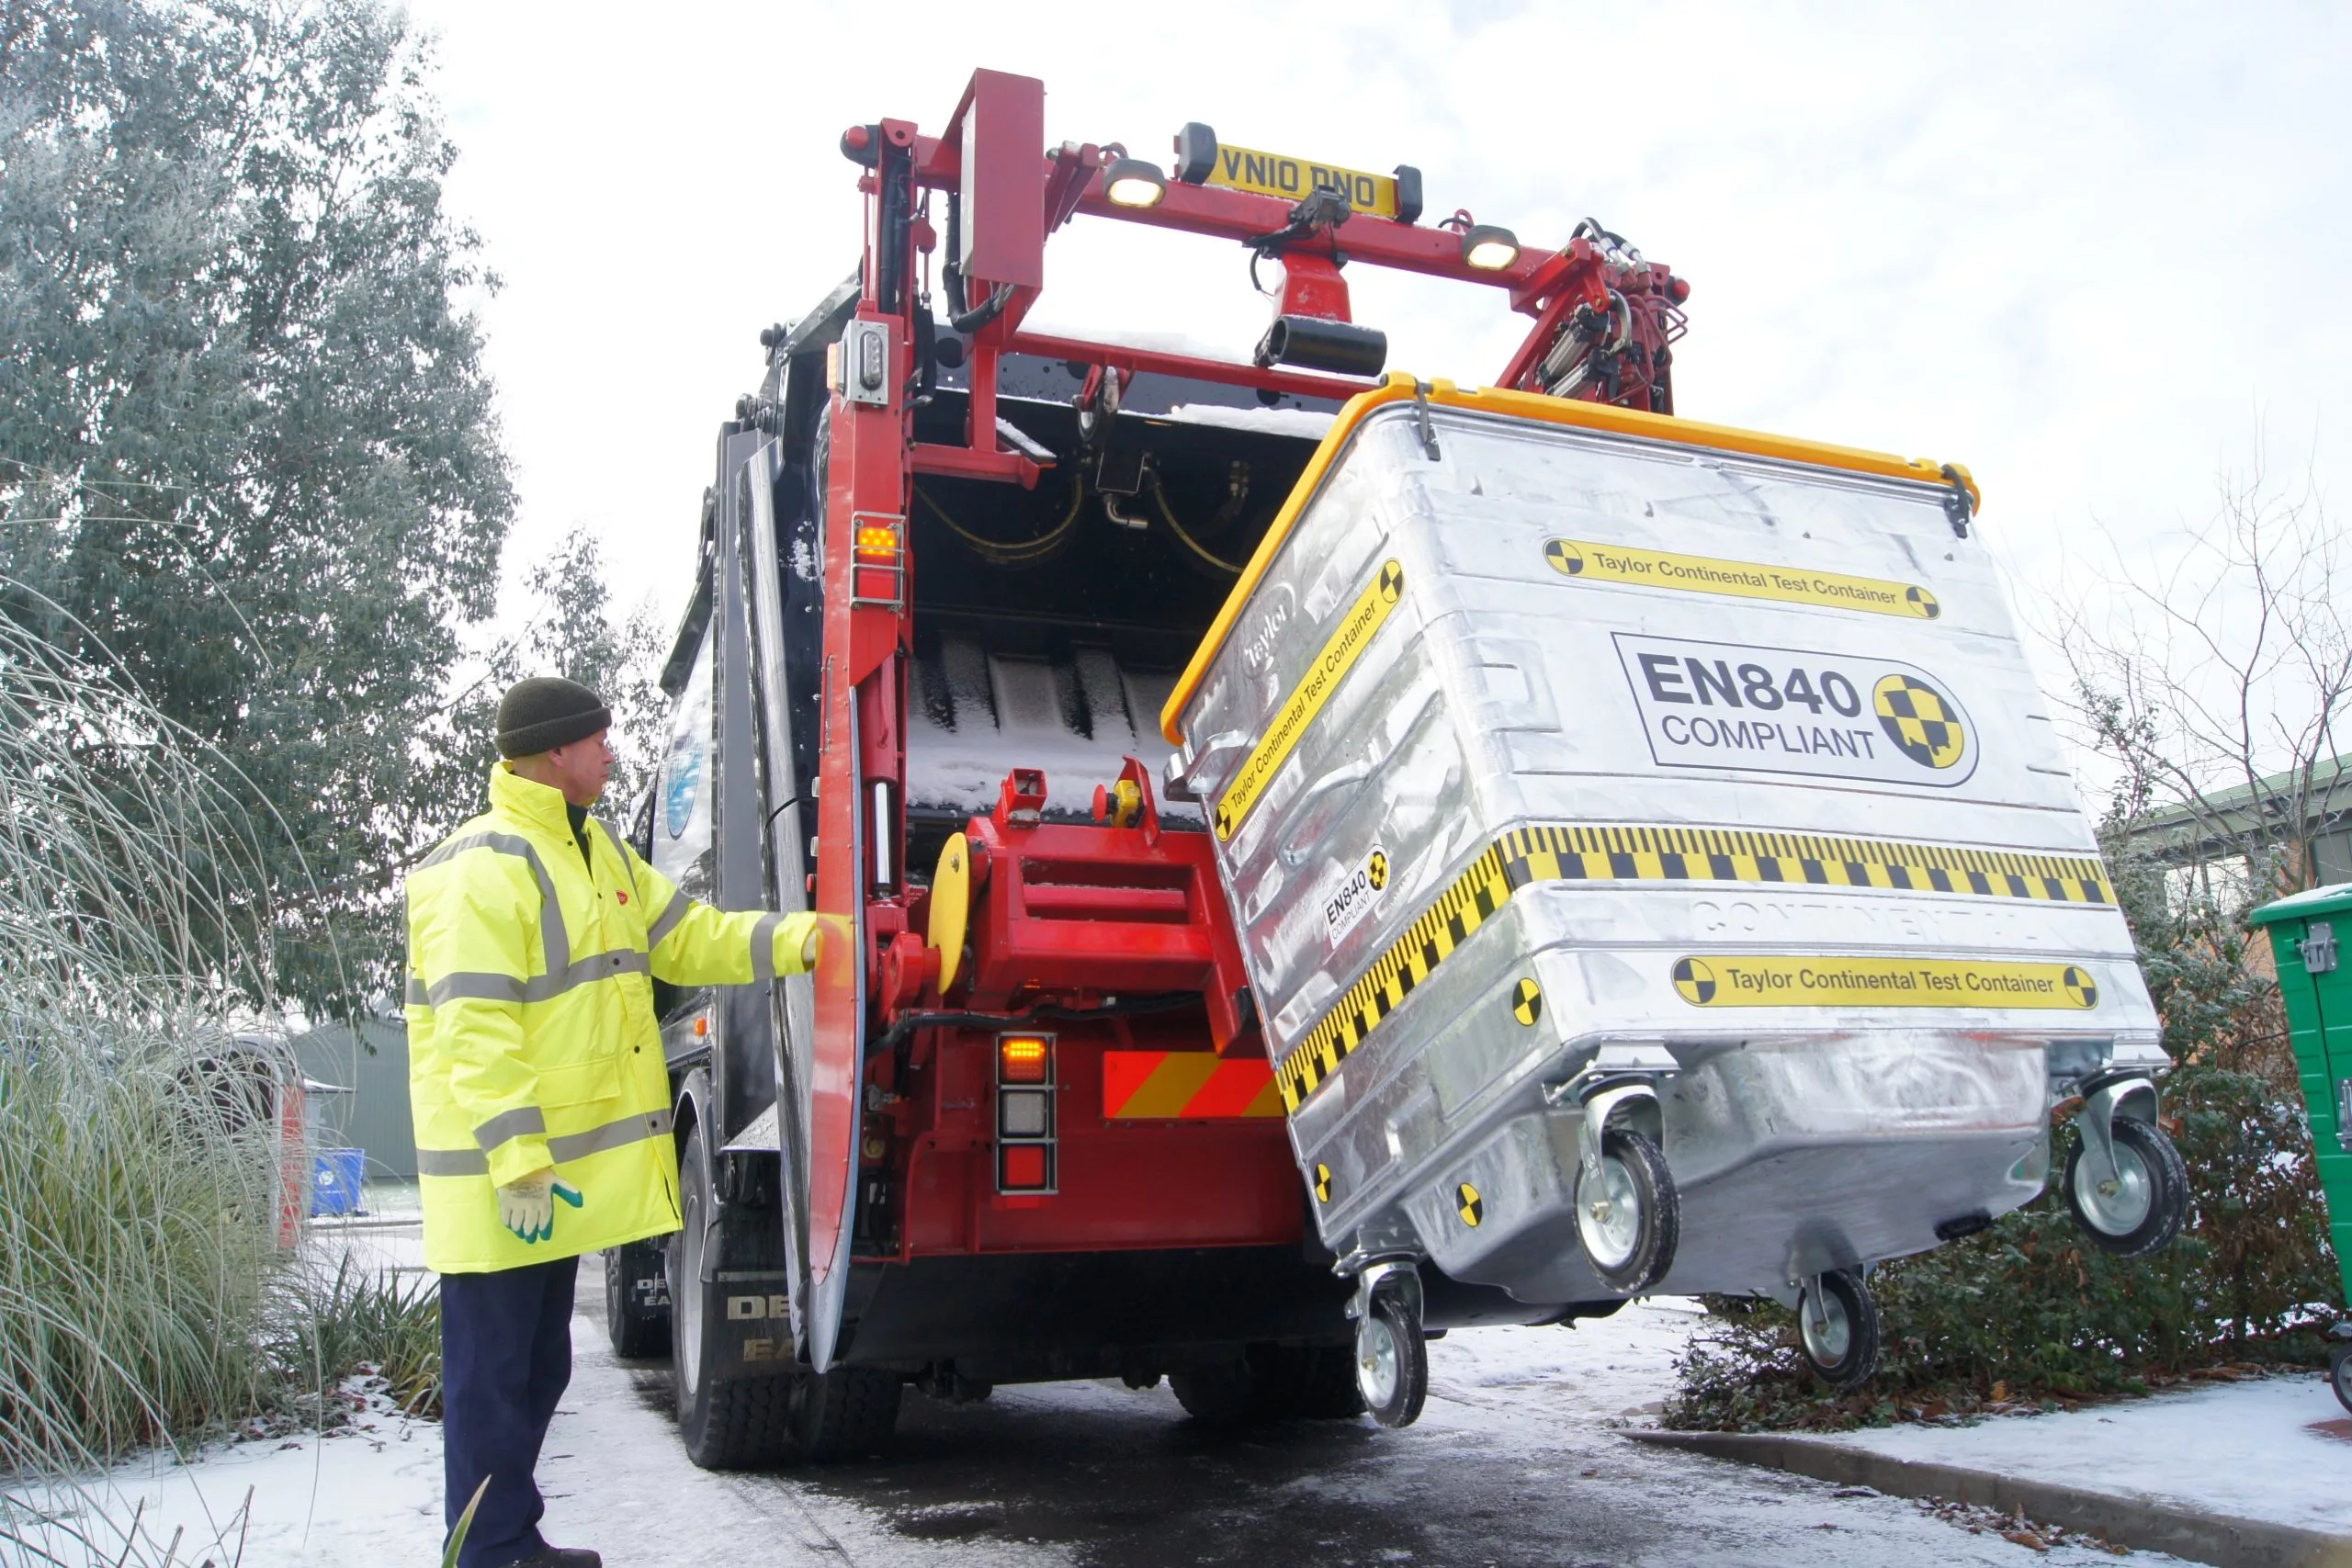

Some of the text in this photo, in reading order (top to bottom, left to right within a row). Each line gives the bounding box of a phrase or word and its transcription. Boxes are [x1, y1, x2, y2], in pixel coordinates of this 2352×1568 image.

[1593, 552, 1896, 604] Taylor Continental Test Container
[1231, 599, 1375, 809] Taylor Continental Test Container
[1636, 652, 1862, 718] EN840
[1661, 715, 1876, 760] COMPLIANT
[1327, 870, 1366, 926] EN840
[1332, 889, 1372, 940] COMPLIANT
[1726, 969, 2053, 993] Taylor Continental Test Container
